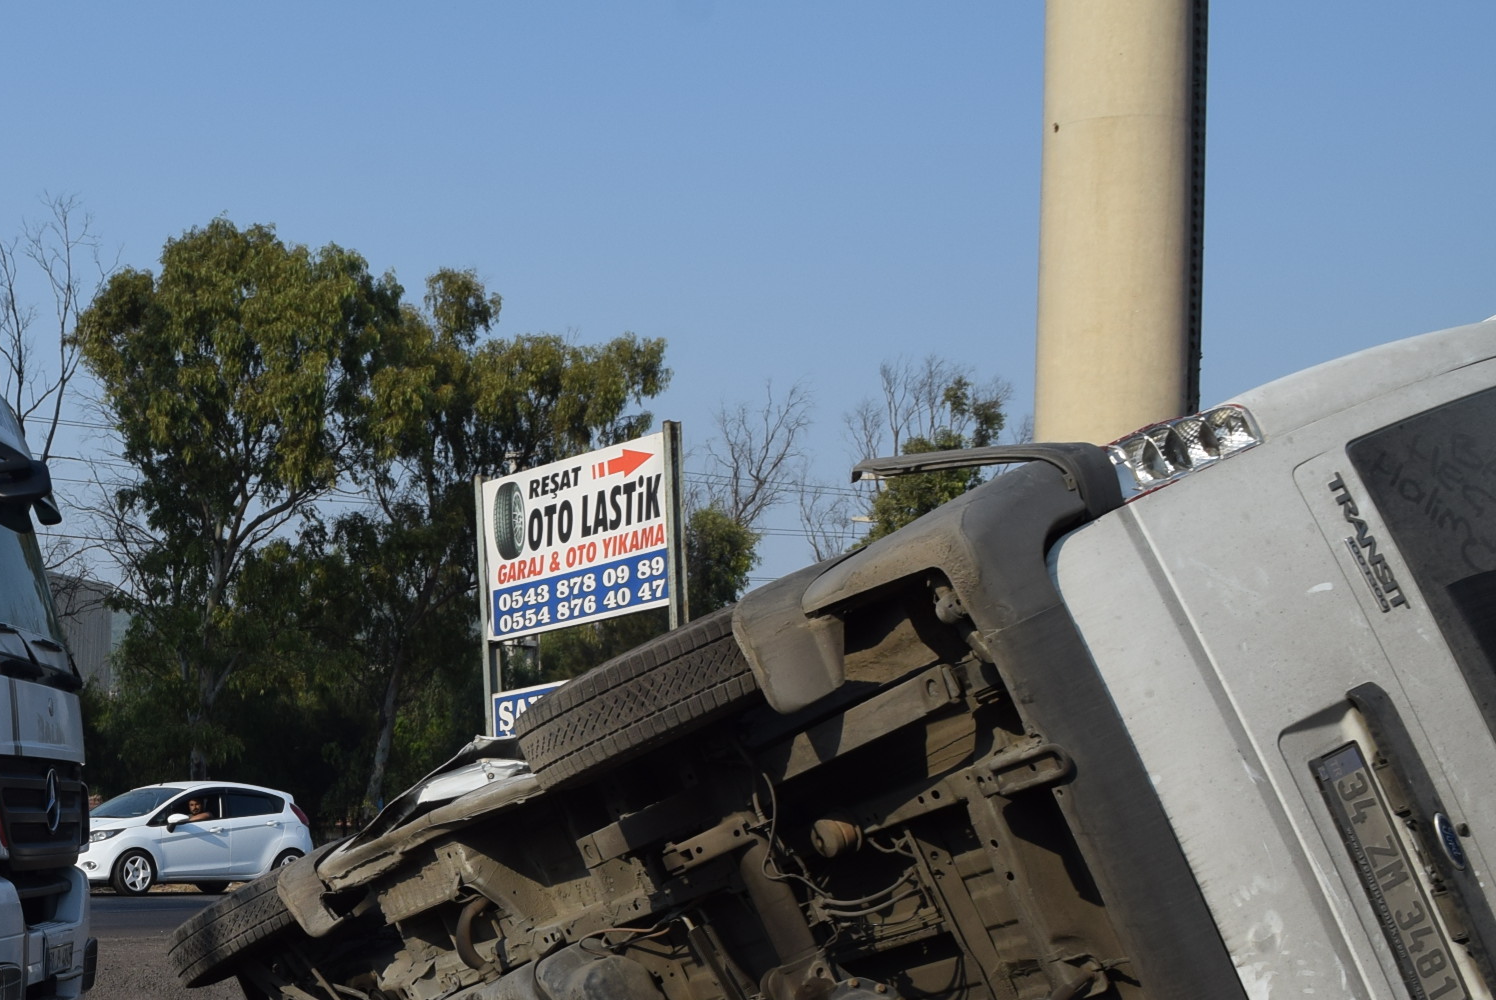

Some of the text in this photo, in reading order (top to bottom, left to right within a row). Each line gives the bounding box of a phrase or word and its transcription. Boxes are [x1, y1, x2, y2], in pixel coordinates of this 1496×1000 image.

[528, 466, 582, 499] REŞAT
[528, 500, 573, 551] OTO
[1328, 471, 1411, 610] TRANSIT
[497, 523, 665, 585] GARAJ & OTO YIKAMA
[498, 556, 665, 612] 0543 878 09 89
[499, 578, 666, 632] 0554 876 40 47
[1337, 771, 1377, 825] 34
[1364, 834, 1410, 892] ZM
